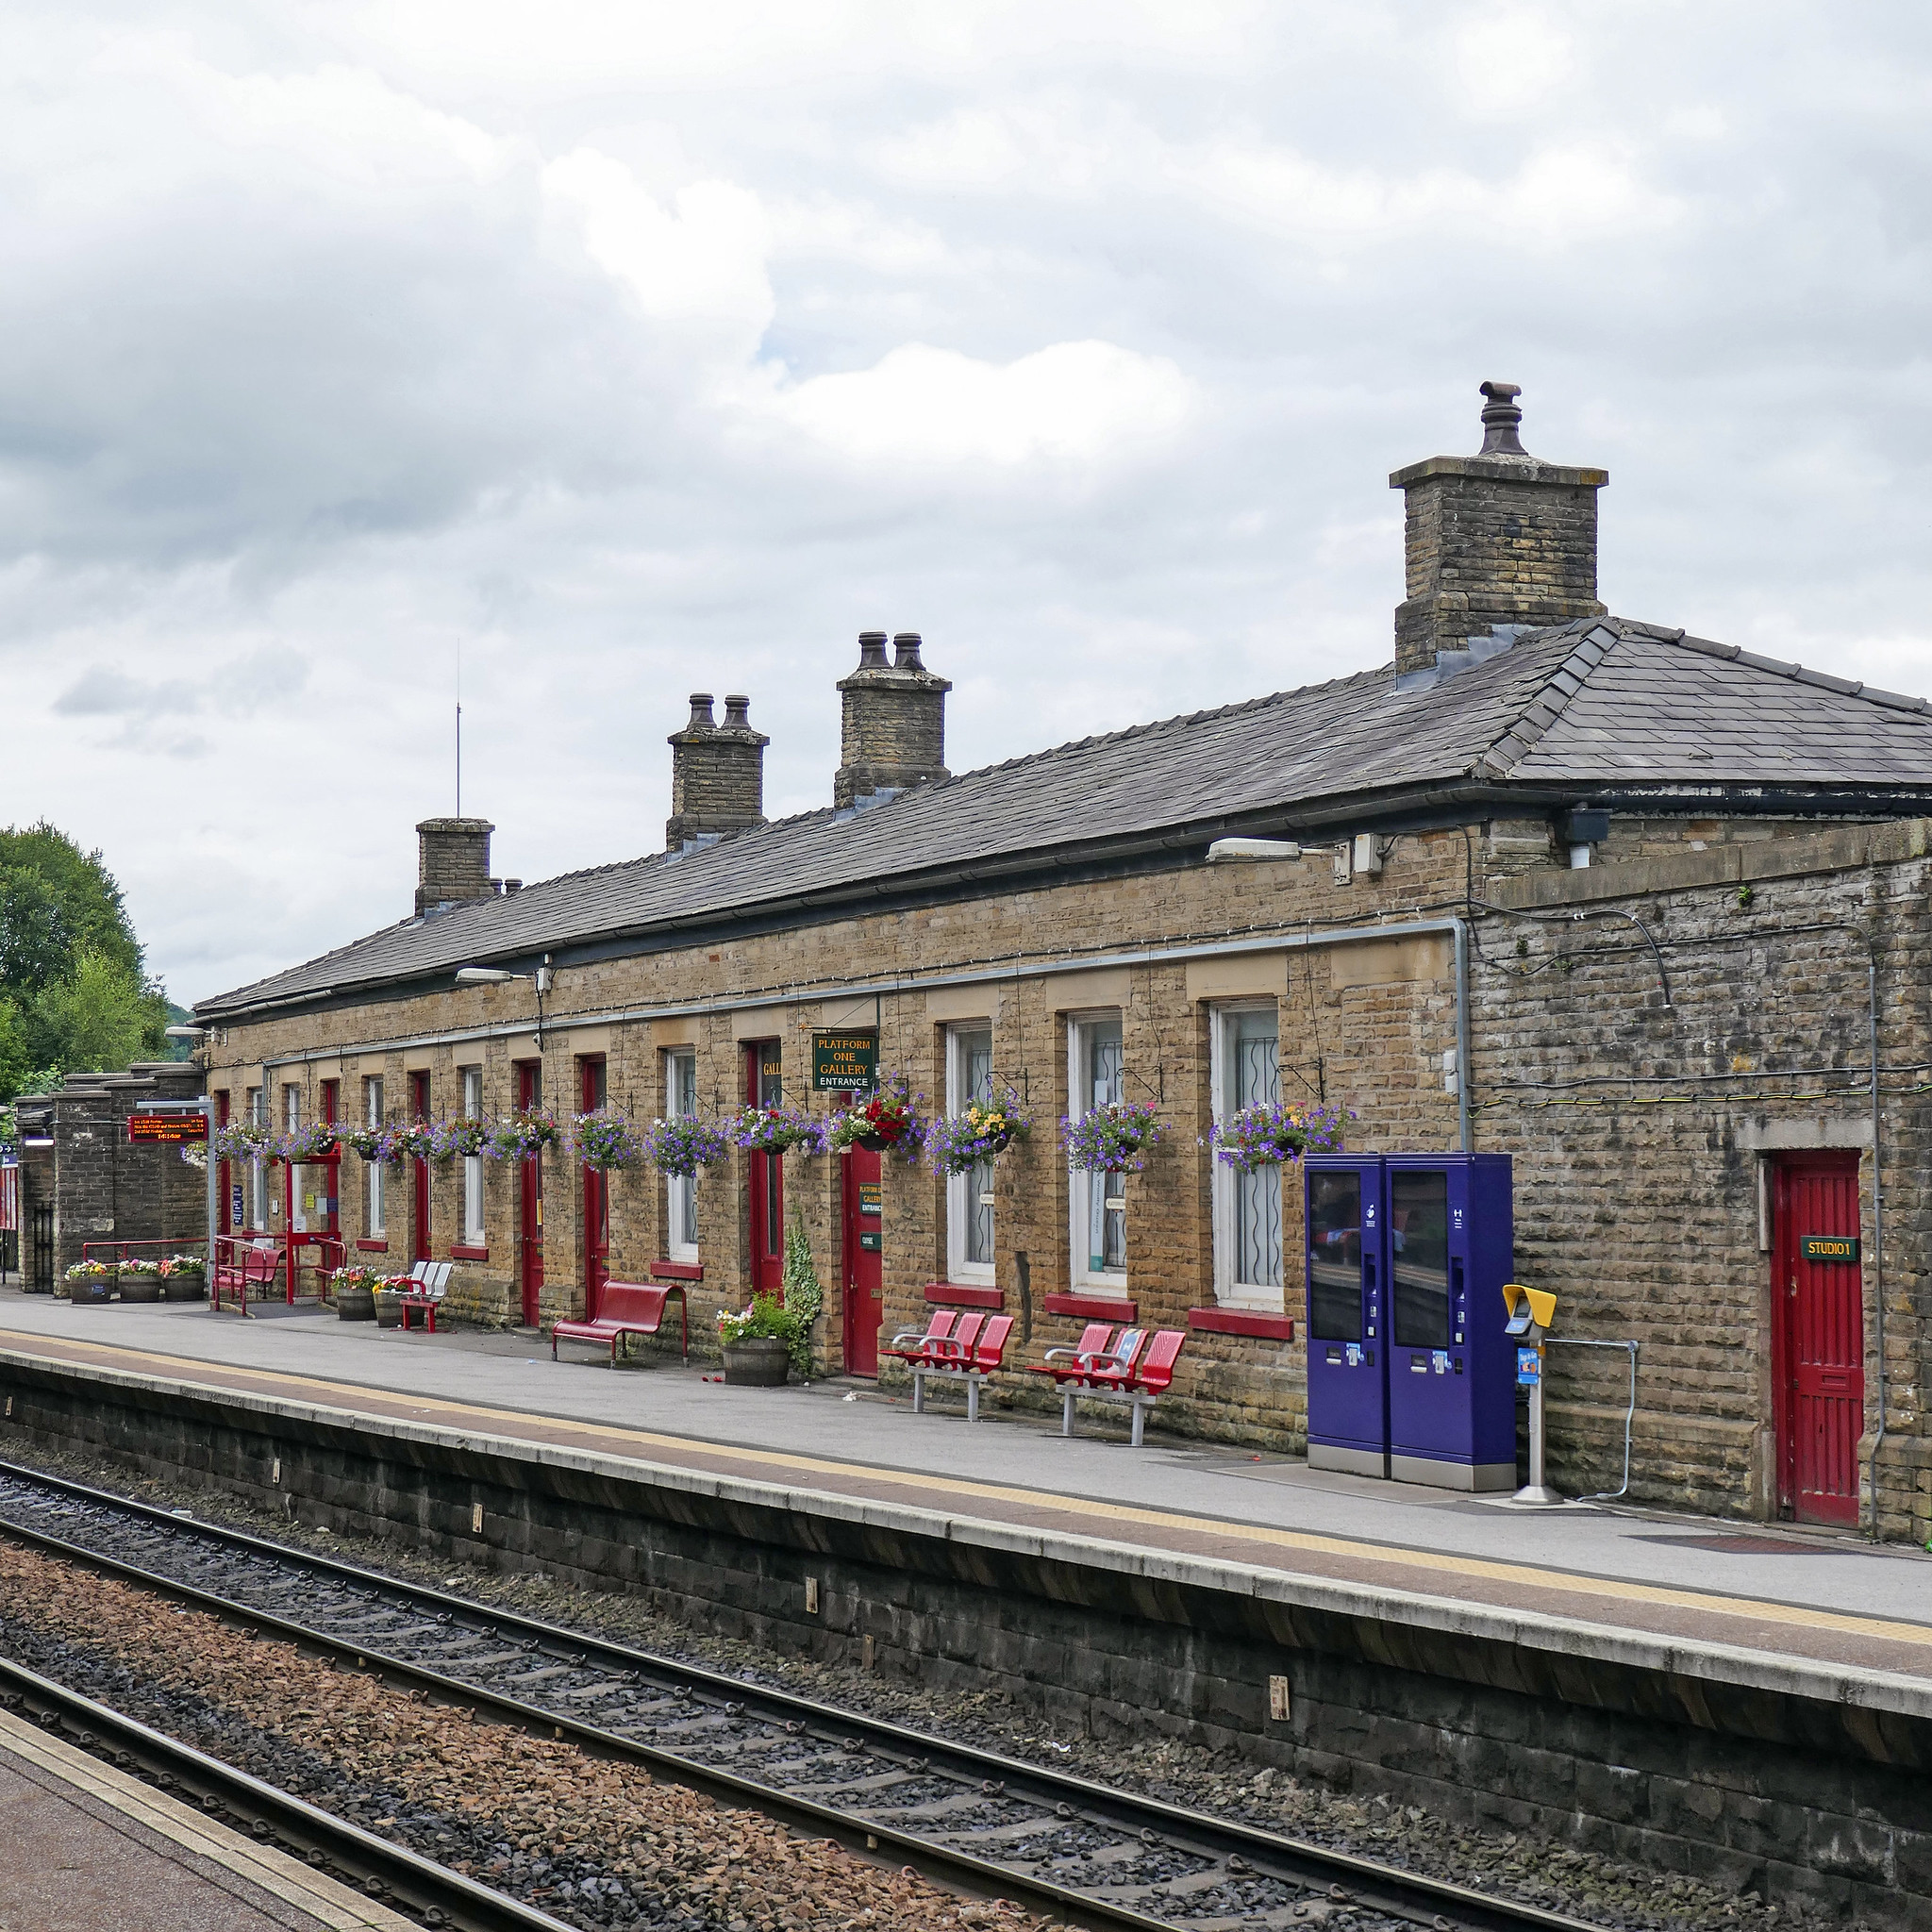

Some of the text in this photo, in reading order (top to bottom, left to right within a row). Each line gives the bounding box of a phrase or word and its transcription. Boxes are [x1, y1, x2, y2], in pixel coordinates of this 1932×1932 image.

[818, 1039, 871, 1050] PLATFORM
[833, 1052, 856, 1062] ONE
[763, 1062, 783, 1075] GALL
[820, 1064, 868, 1074] GALLERY
[820, 1077, 869, 1087] ENTRANCE
[861, 1204, 882, 1212] ENTRANC
[1807, 1241, 1851, 1256] STUDIO 1
